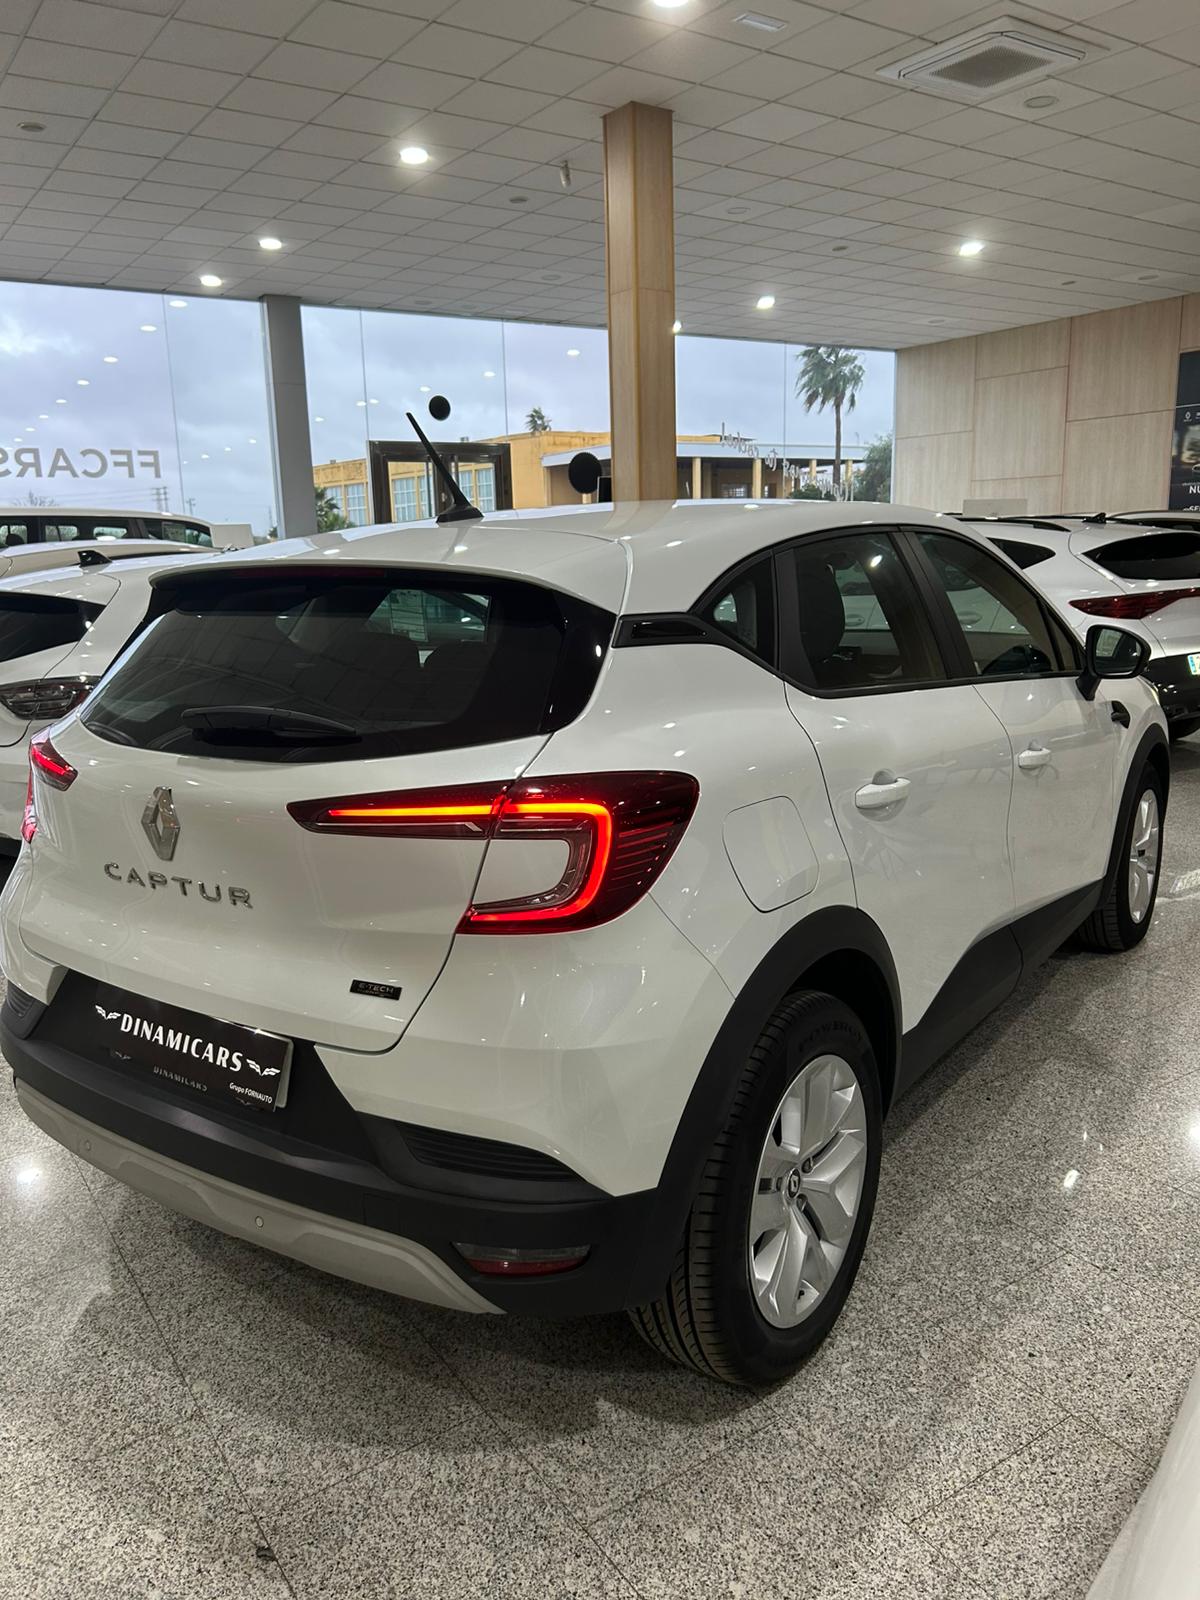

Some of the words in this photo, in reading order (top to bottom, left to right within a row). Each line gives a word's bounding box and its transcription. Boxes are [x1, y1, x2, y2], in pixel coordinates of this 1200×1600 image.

[104, 862, 253, 909] CAPTUR
[120, 1013, 242, 1072] DINAMICARS
[229, 1082, 245, 1094] Grupo
[244, 1087, 273, 1104] FORNAUTO
